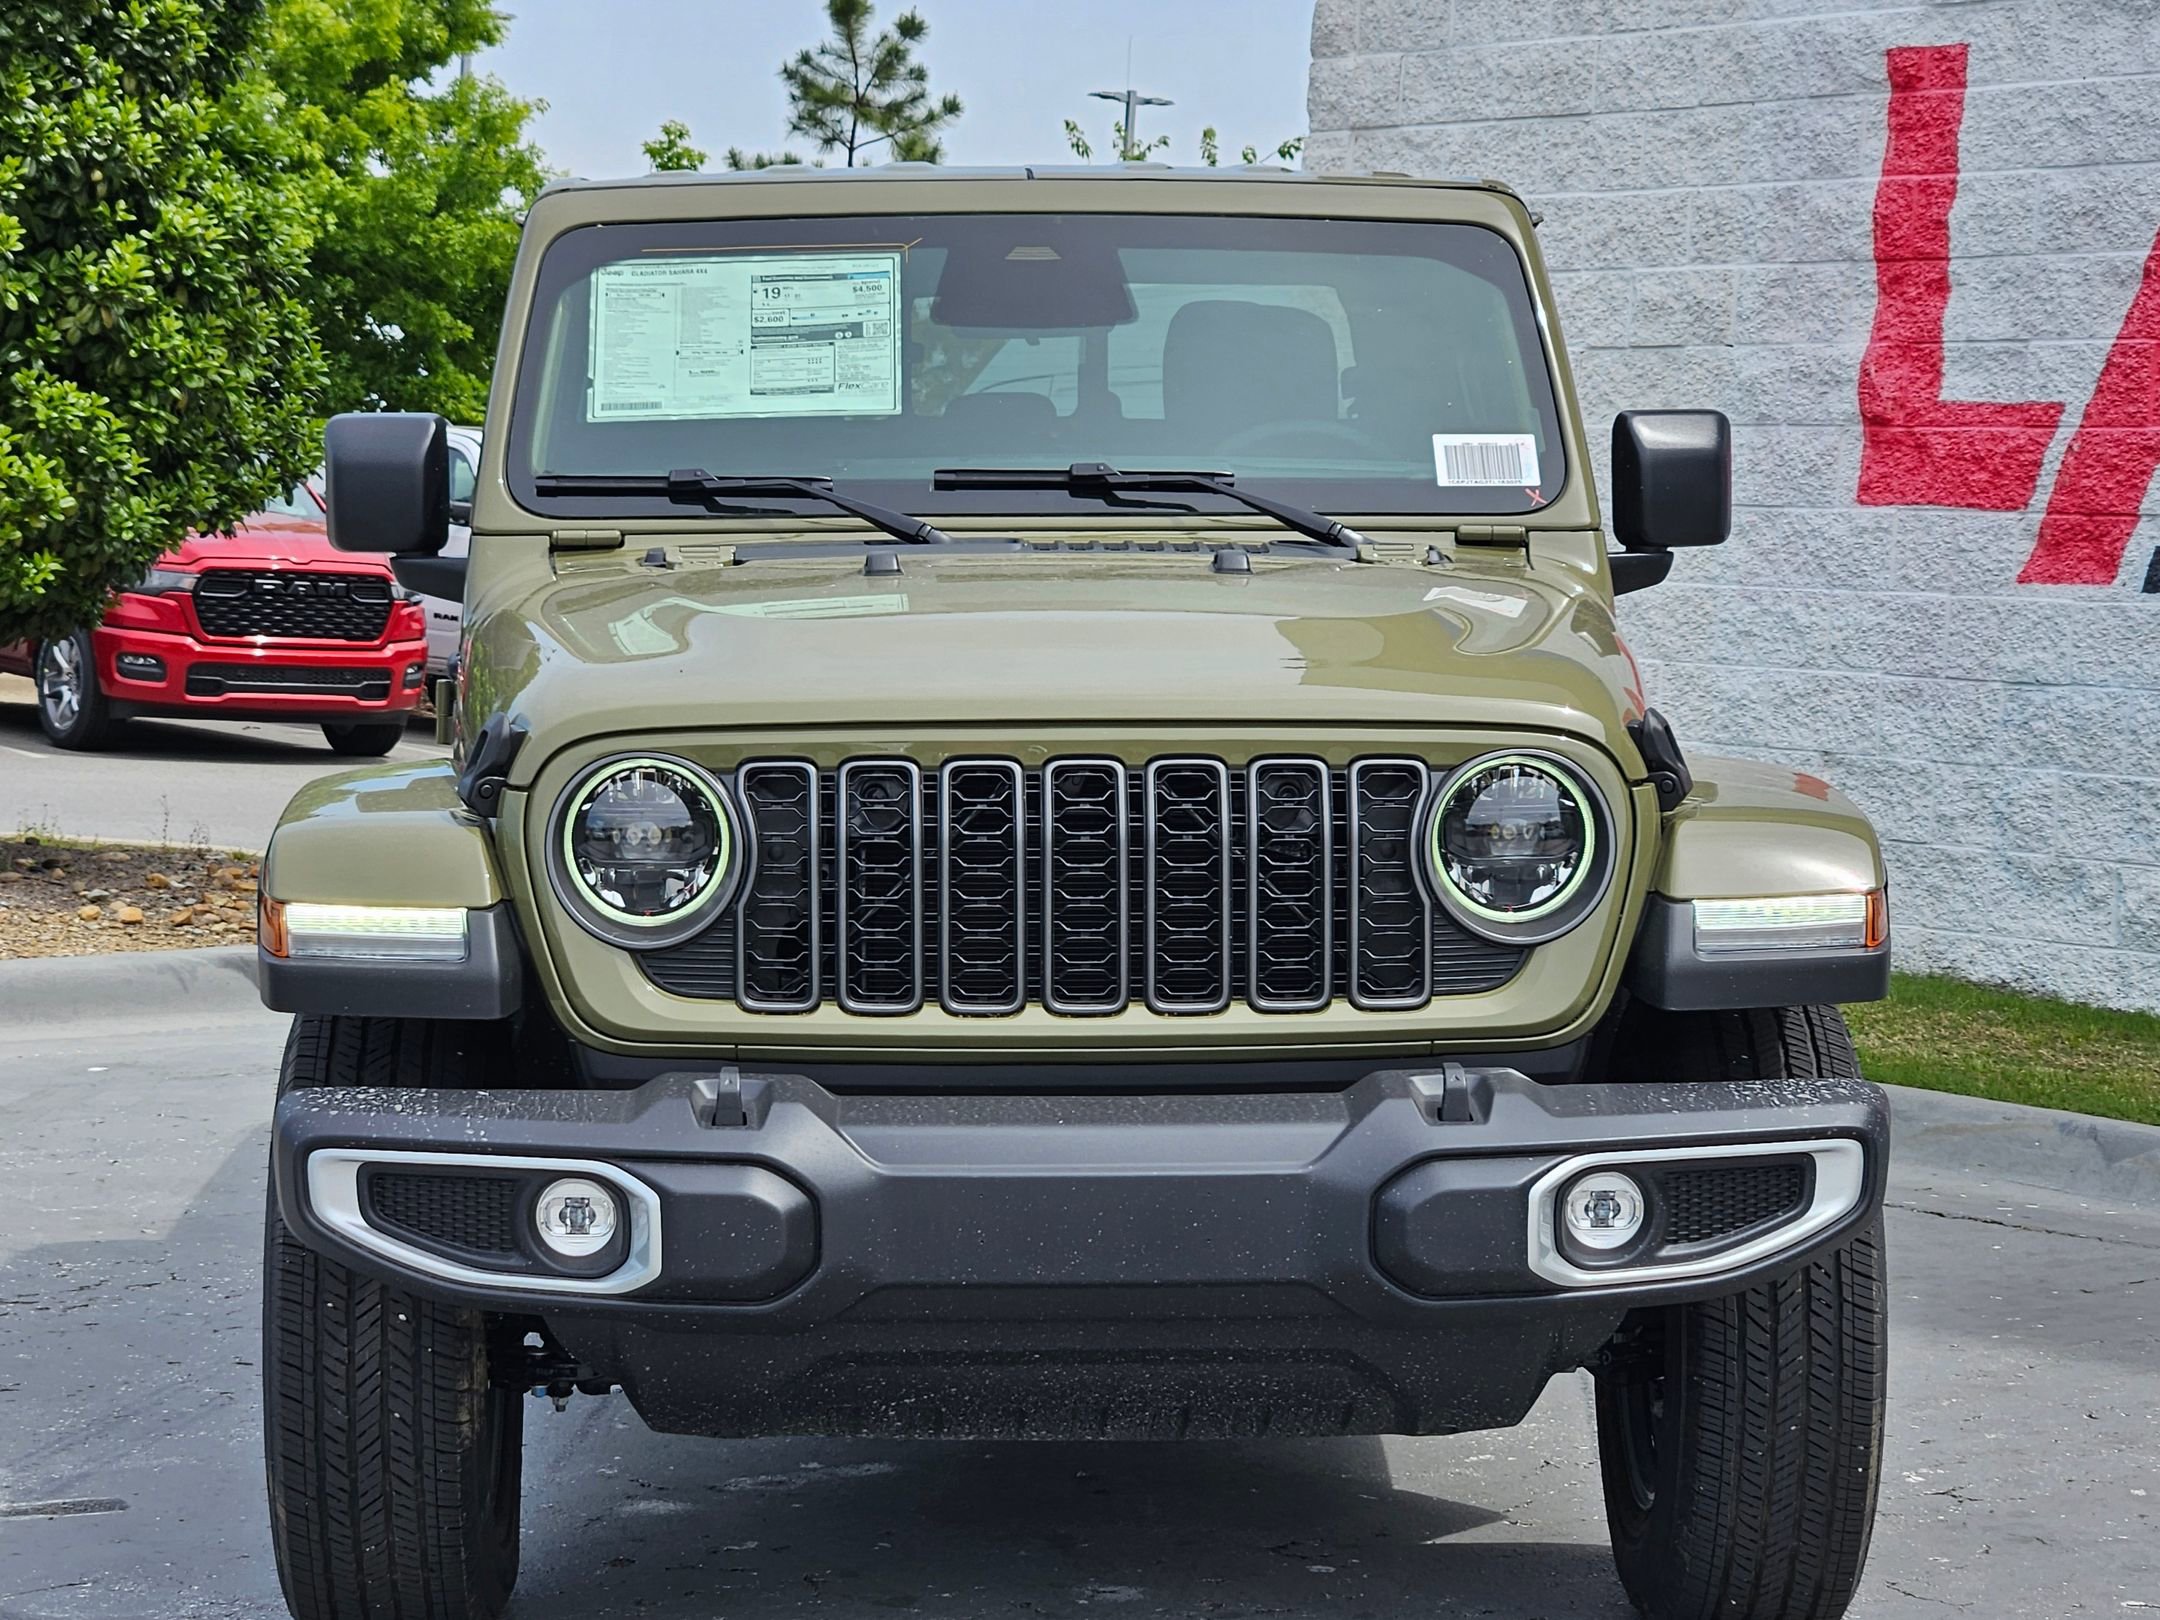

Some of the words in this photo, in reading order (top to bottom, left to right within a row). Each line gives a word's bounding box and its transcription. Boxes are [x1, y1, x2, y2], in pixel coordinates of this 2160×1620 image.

[669, 268, 694, 276] SAHARA
[852, 284, 883, 293] $4,500
[762, 287, 781, 300] 19
[754, 316, 784, 324] $2,600
[255, 579, 347, 597] RAM
[433, 612, 459, 622] RAM
